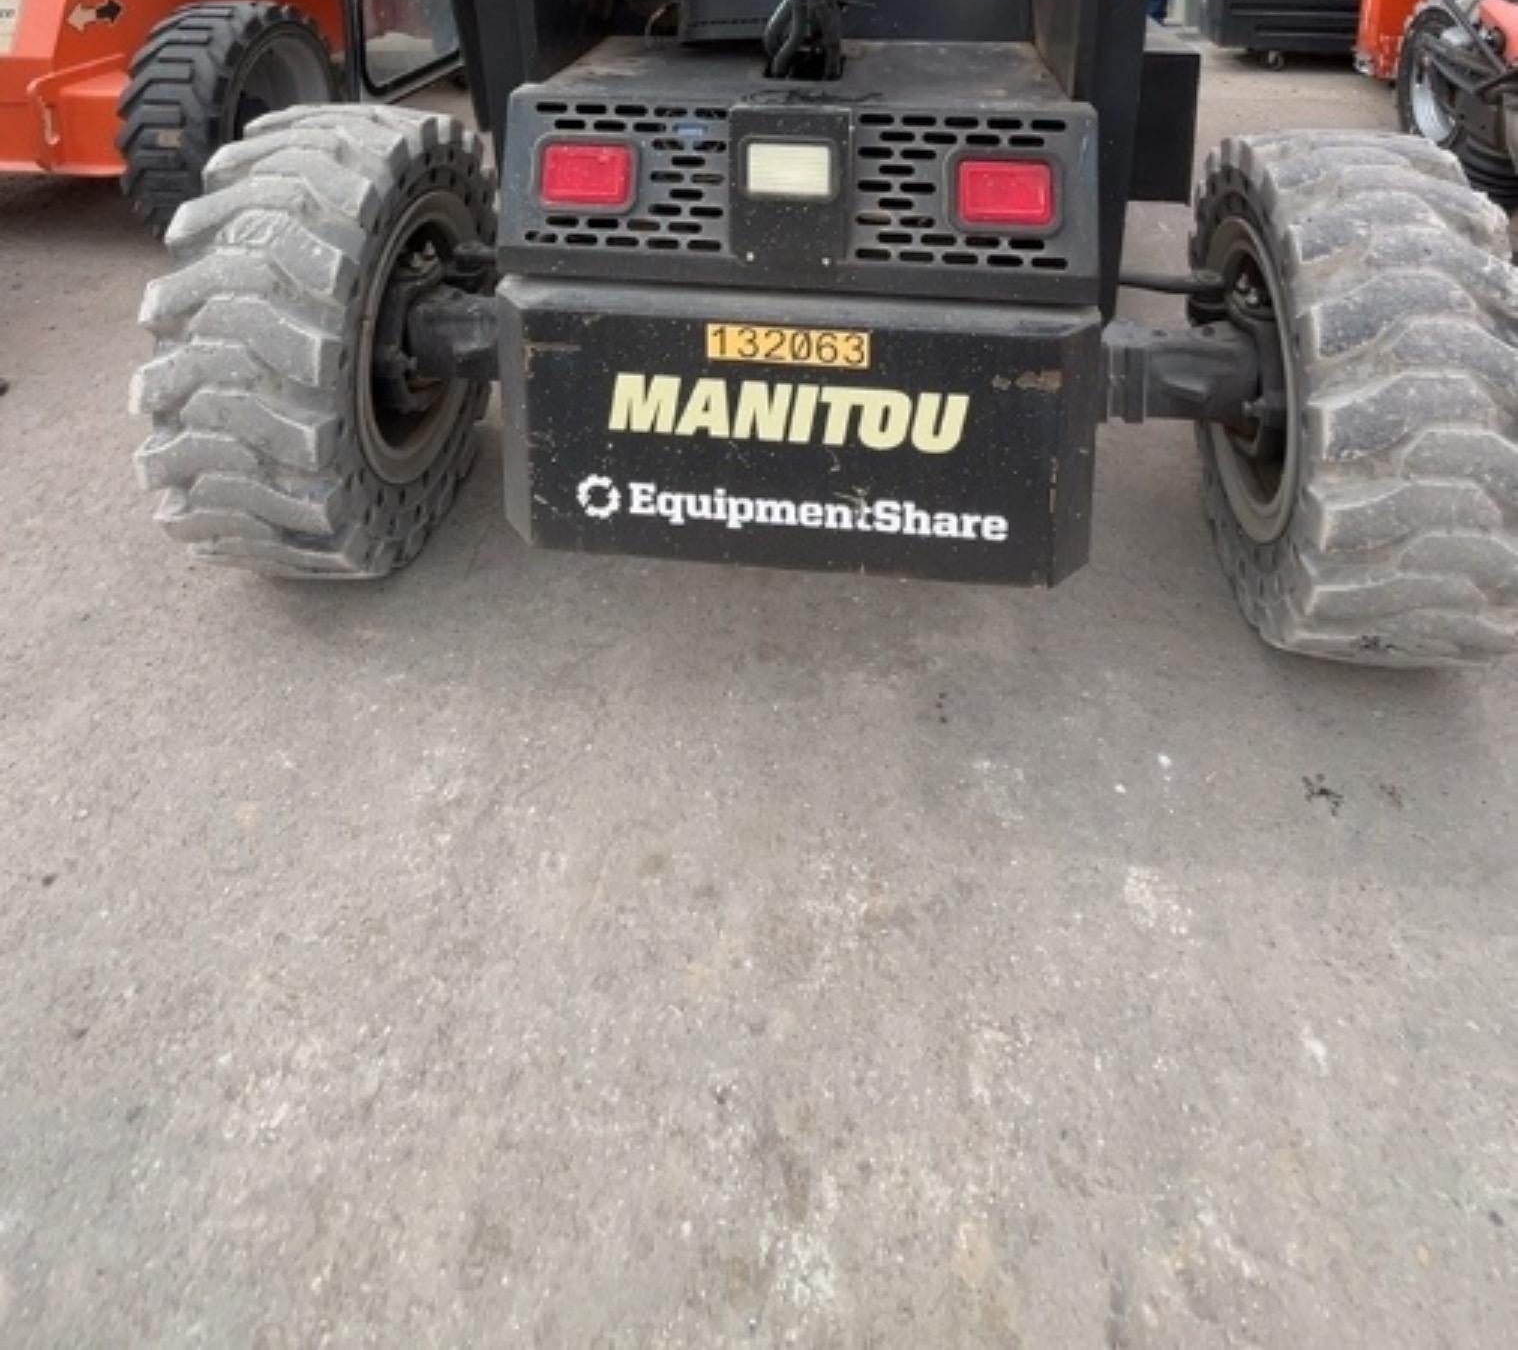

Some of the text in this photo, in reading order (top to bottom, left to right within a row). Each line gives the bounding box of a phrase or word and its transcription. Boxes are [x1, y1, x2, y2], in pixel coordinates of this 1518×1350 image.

[711, 325, 866, 364] 132063
[607, 372, 970, 454] MANITOU
[628, 481, 1009, 541] EquipmentShare
